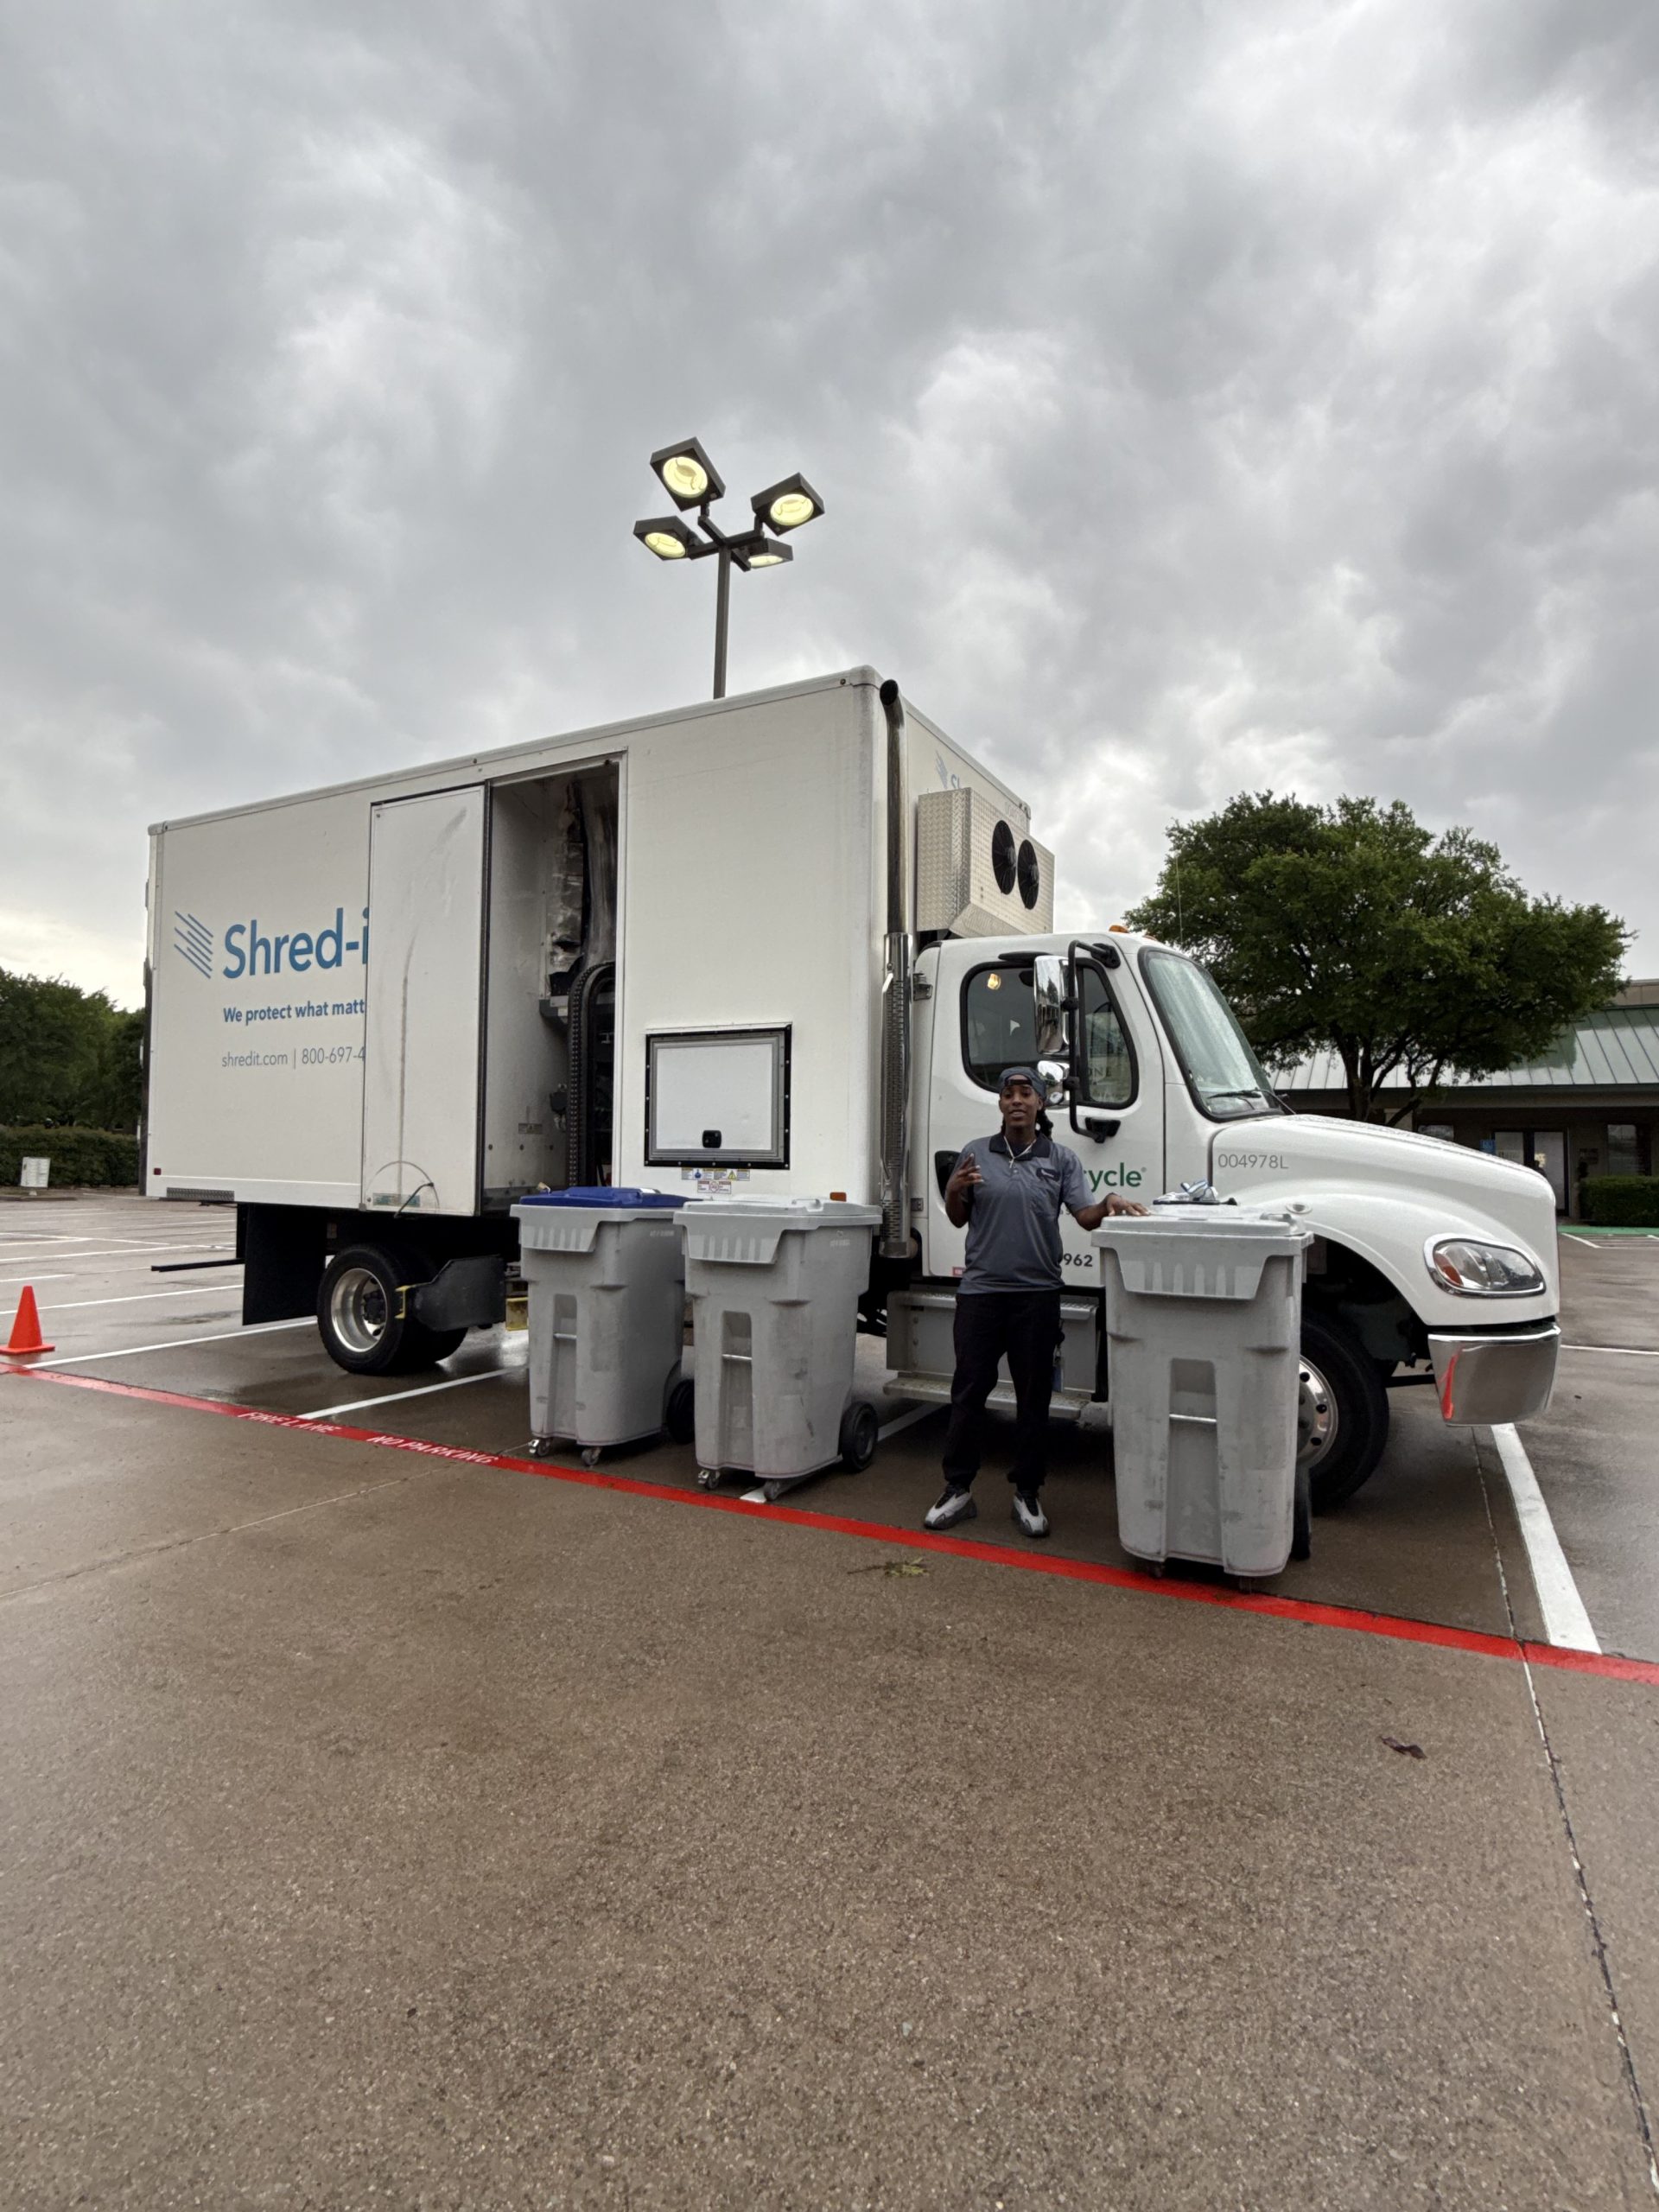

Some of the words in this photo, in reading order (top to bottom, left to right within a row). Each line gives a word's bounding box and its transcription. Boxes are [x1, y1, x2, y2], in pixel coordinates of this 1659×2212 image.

[223, 1007, 243, 1023] We
[245, 1004, 292, 1027] protect
[295, 1000, 328, 1018] what
[332, 999, 365, 1015] matt
[222, 1051, 288, 1068] shredit.com
[1217, 1154, 1289, 1169] 004978L
[1084, 1162, 1142, 1192] ycle
[238, 1411, 292, 1424] FIRE
[280, 1419, 342, 1433] LANE
[366, 1435, 404, 1445] NO
[397, 1441, 499, 1464] PARKING
